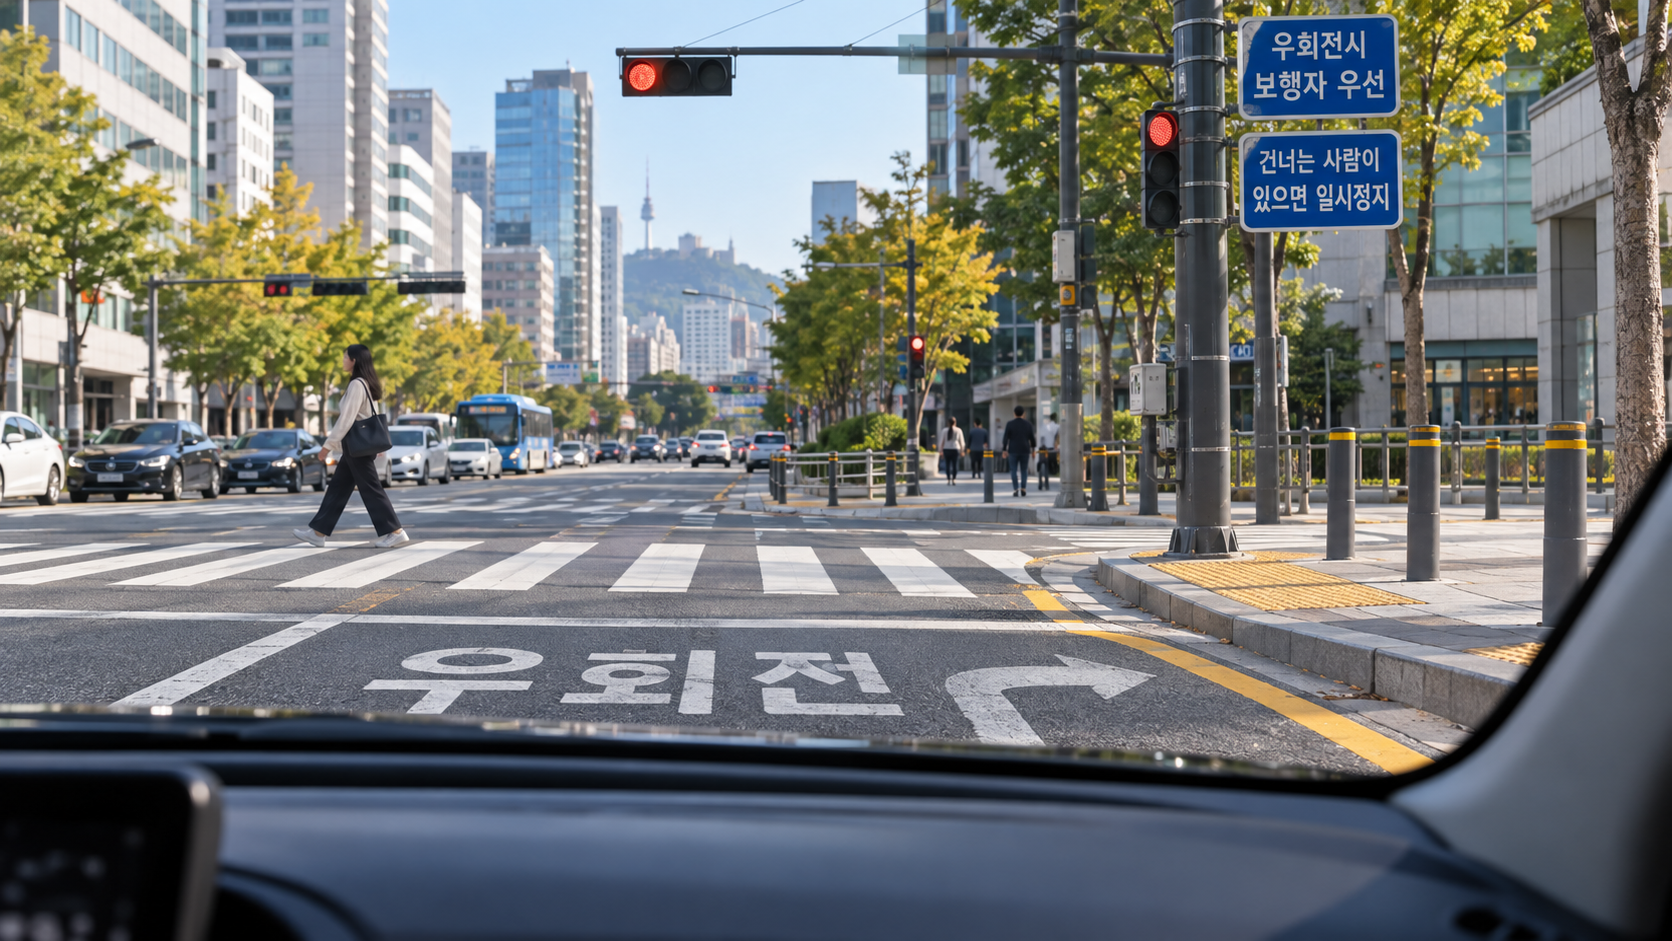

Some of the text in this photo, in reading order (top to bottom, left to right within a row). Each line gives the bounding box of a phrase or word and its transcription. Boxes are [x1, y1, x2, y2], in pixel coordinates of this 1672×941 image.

[1271, 30, 1366, 61] 우회전시
[1253, 69, 1385, 102] 보행자 우선
[1259, 146, 1380, 175] 건너는 사람이
[1252, 182, 1390, 213] 있으면 일시정지
[362, 646, 905, 716] 우회전
